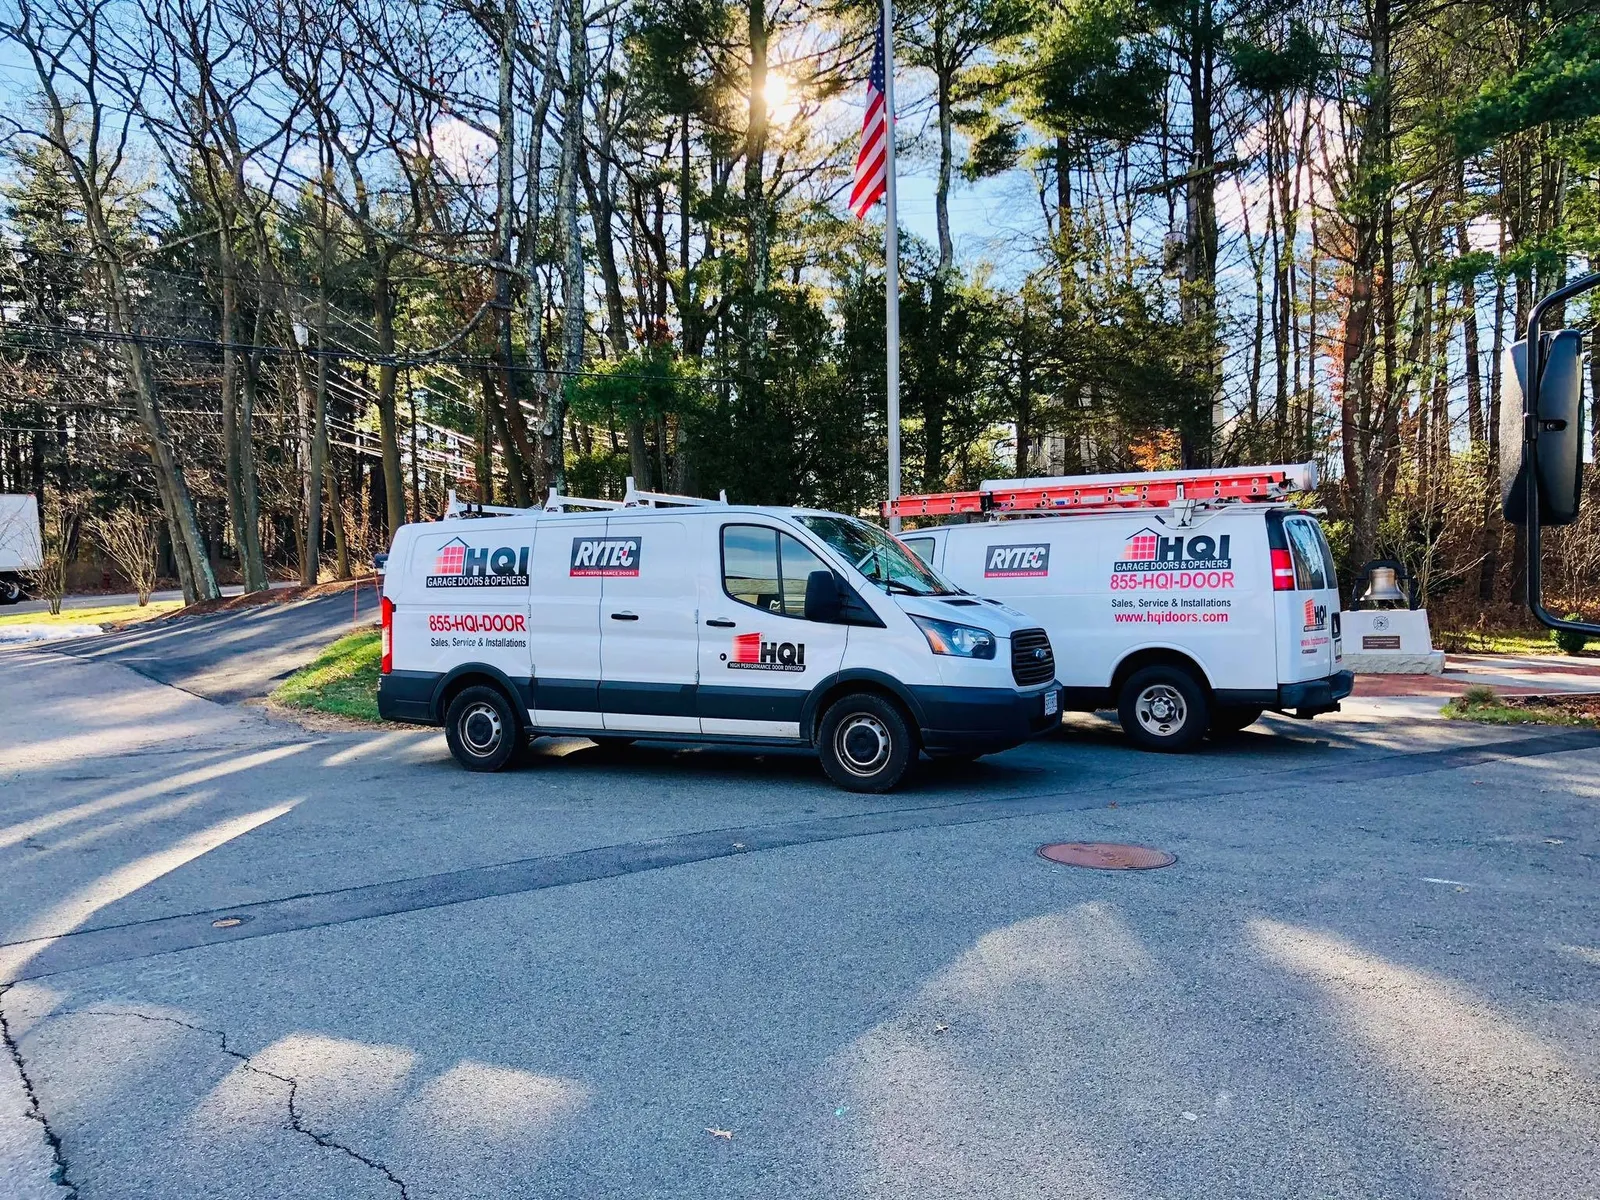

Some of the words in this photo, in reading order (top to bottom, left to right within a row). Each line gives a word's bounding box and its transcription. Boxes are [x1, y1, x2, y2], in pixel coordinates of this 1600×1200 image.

[574, 541, 637, 567] RYTEC
[1159, 534, 1230, 561] HQI
[466, 547, 530, 575] HQI
[988, 547, 1046, 569] RYTEC
[1115, 562, 1149, 571] GARAGE
[1150, 561, 1180, 570] DOORS
[1181, 561, 1187, 569] &
[1187, 559, 1229, 569] OPENERS
[427, 577, 457, 587] GARAGE
[458, 576, 483, 586] DOORS
[484, 576, 490, 585] &
[490, 575, 527, 585] OPENERS
[1110, 571, 1235, 590] 855-HQI-DOOR
[1111, 598, 1136, 608] Sales,
[1138, 598, 1169, 608] Service
[1171, 598, 1178, 608] &
[1180, 598, 1232, 608] Installations
[429, 614, 527, 632] 855-HQI-DOOR
[1114, 611, 1229, 625] www.hqidoors.com
[1314, 605, 1327, 624] HQI
[430, 637, 450, 648] Sales,
[452, 637, 477, 648] Service
[477, 638, 484, 647] &
[485, 637, 527, 648] Installations
[760, 642, 805, 665] HQI
